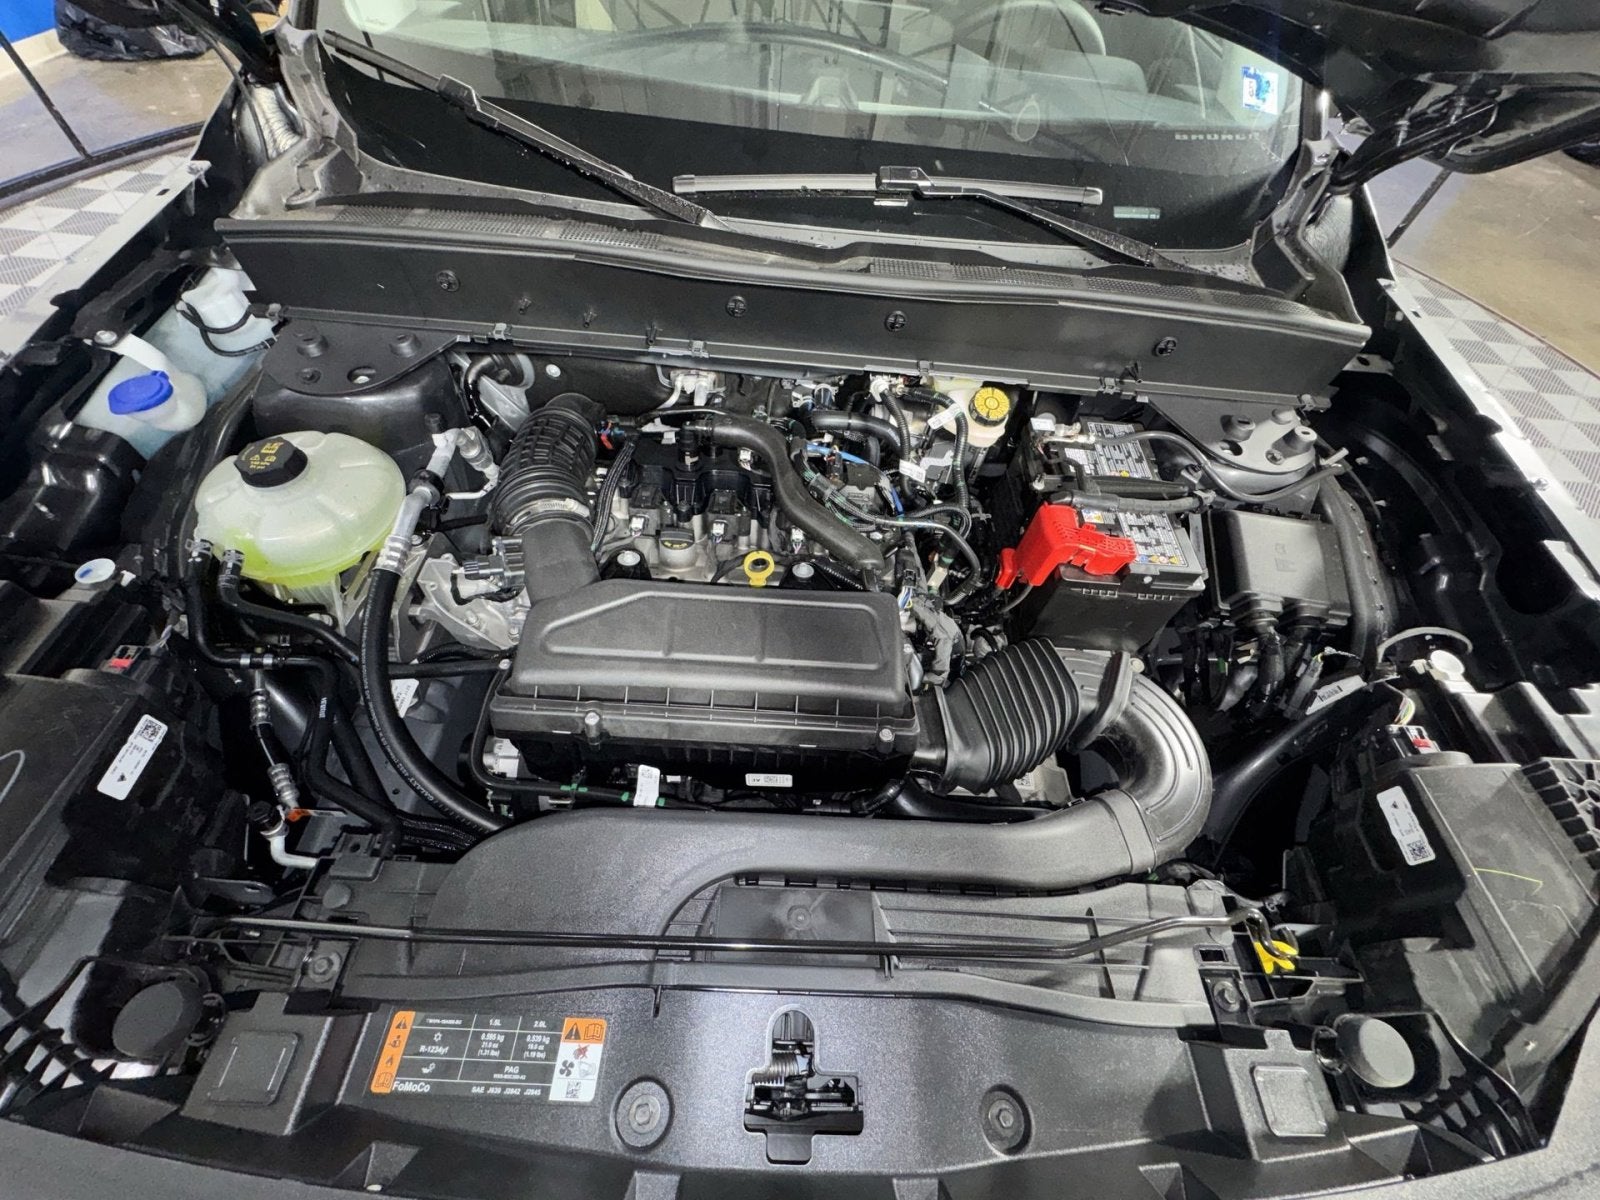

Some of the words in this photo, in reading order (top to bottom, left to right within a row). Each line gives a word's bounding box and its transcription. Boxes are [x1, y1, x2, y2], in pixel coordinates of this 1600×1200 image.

[408, 777, 434, 801] GALAXY
[533, 1020, 547, 1028] 2.0L
[497, 1033, 505, 1042] kg
[543, 1035, 551, 1044] kg
[419, 1045, 449, 1055] R-1234yf
[503, 1065, 520, 1074] PAG
[391, 1081, 431, 1092] FoMoCo
[471, 1086, 485, 1094] SAE
